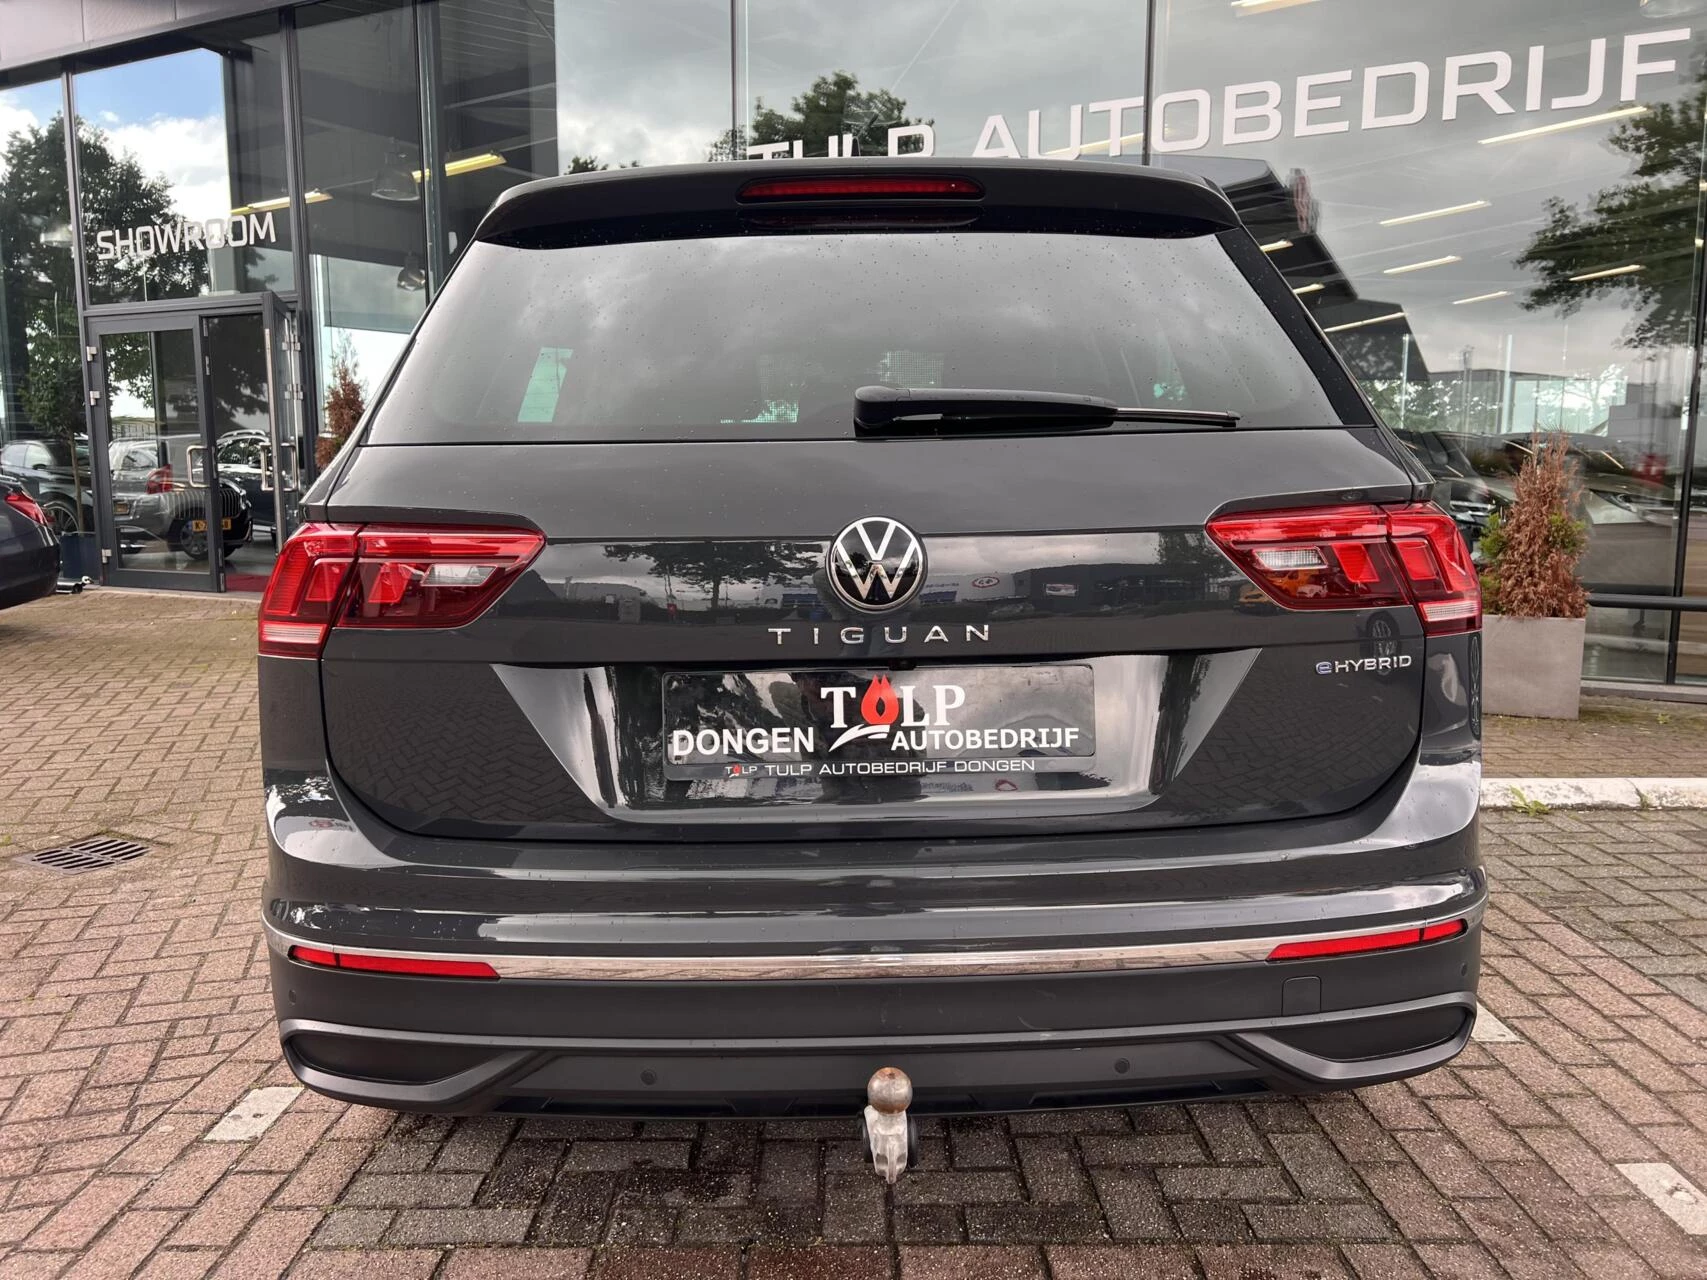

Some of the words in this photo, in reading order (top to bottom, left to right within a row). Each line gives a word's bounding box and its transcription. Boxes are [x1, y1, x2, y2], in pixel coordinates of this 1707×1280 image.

[971, 28, 1691, 160] AUTOBEDRIJF
[97, 211, 277, 261] SHOWROOM
[768, 624, 991, 645] TIGUAN
[672, 726, 815, 757] DONGEN
[890, 726, 1080, 752] AUTOBEDRIJF
[765, 763, 813, 777] TULP
[818, 761, 949, 776] AUTOBEDRIJF
[954, 759, 1036, 773] DONGEN
